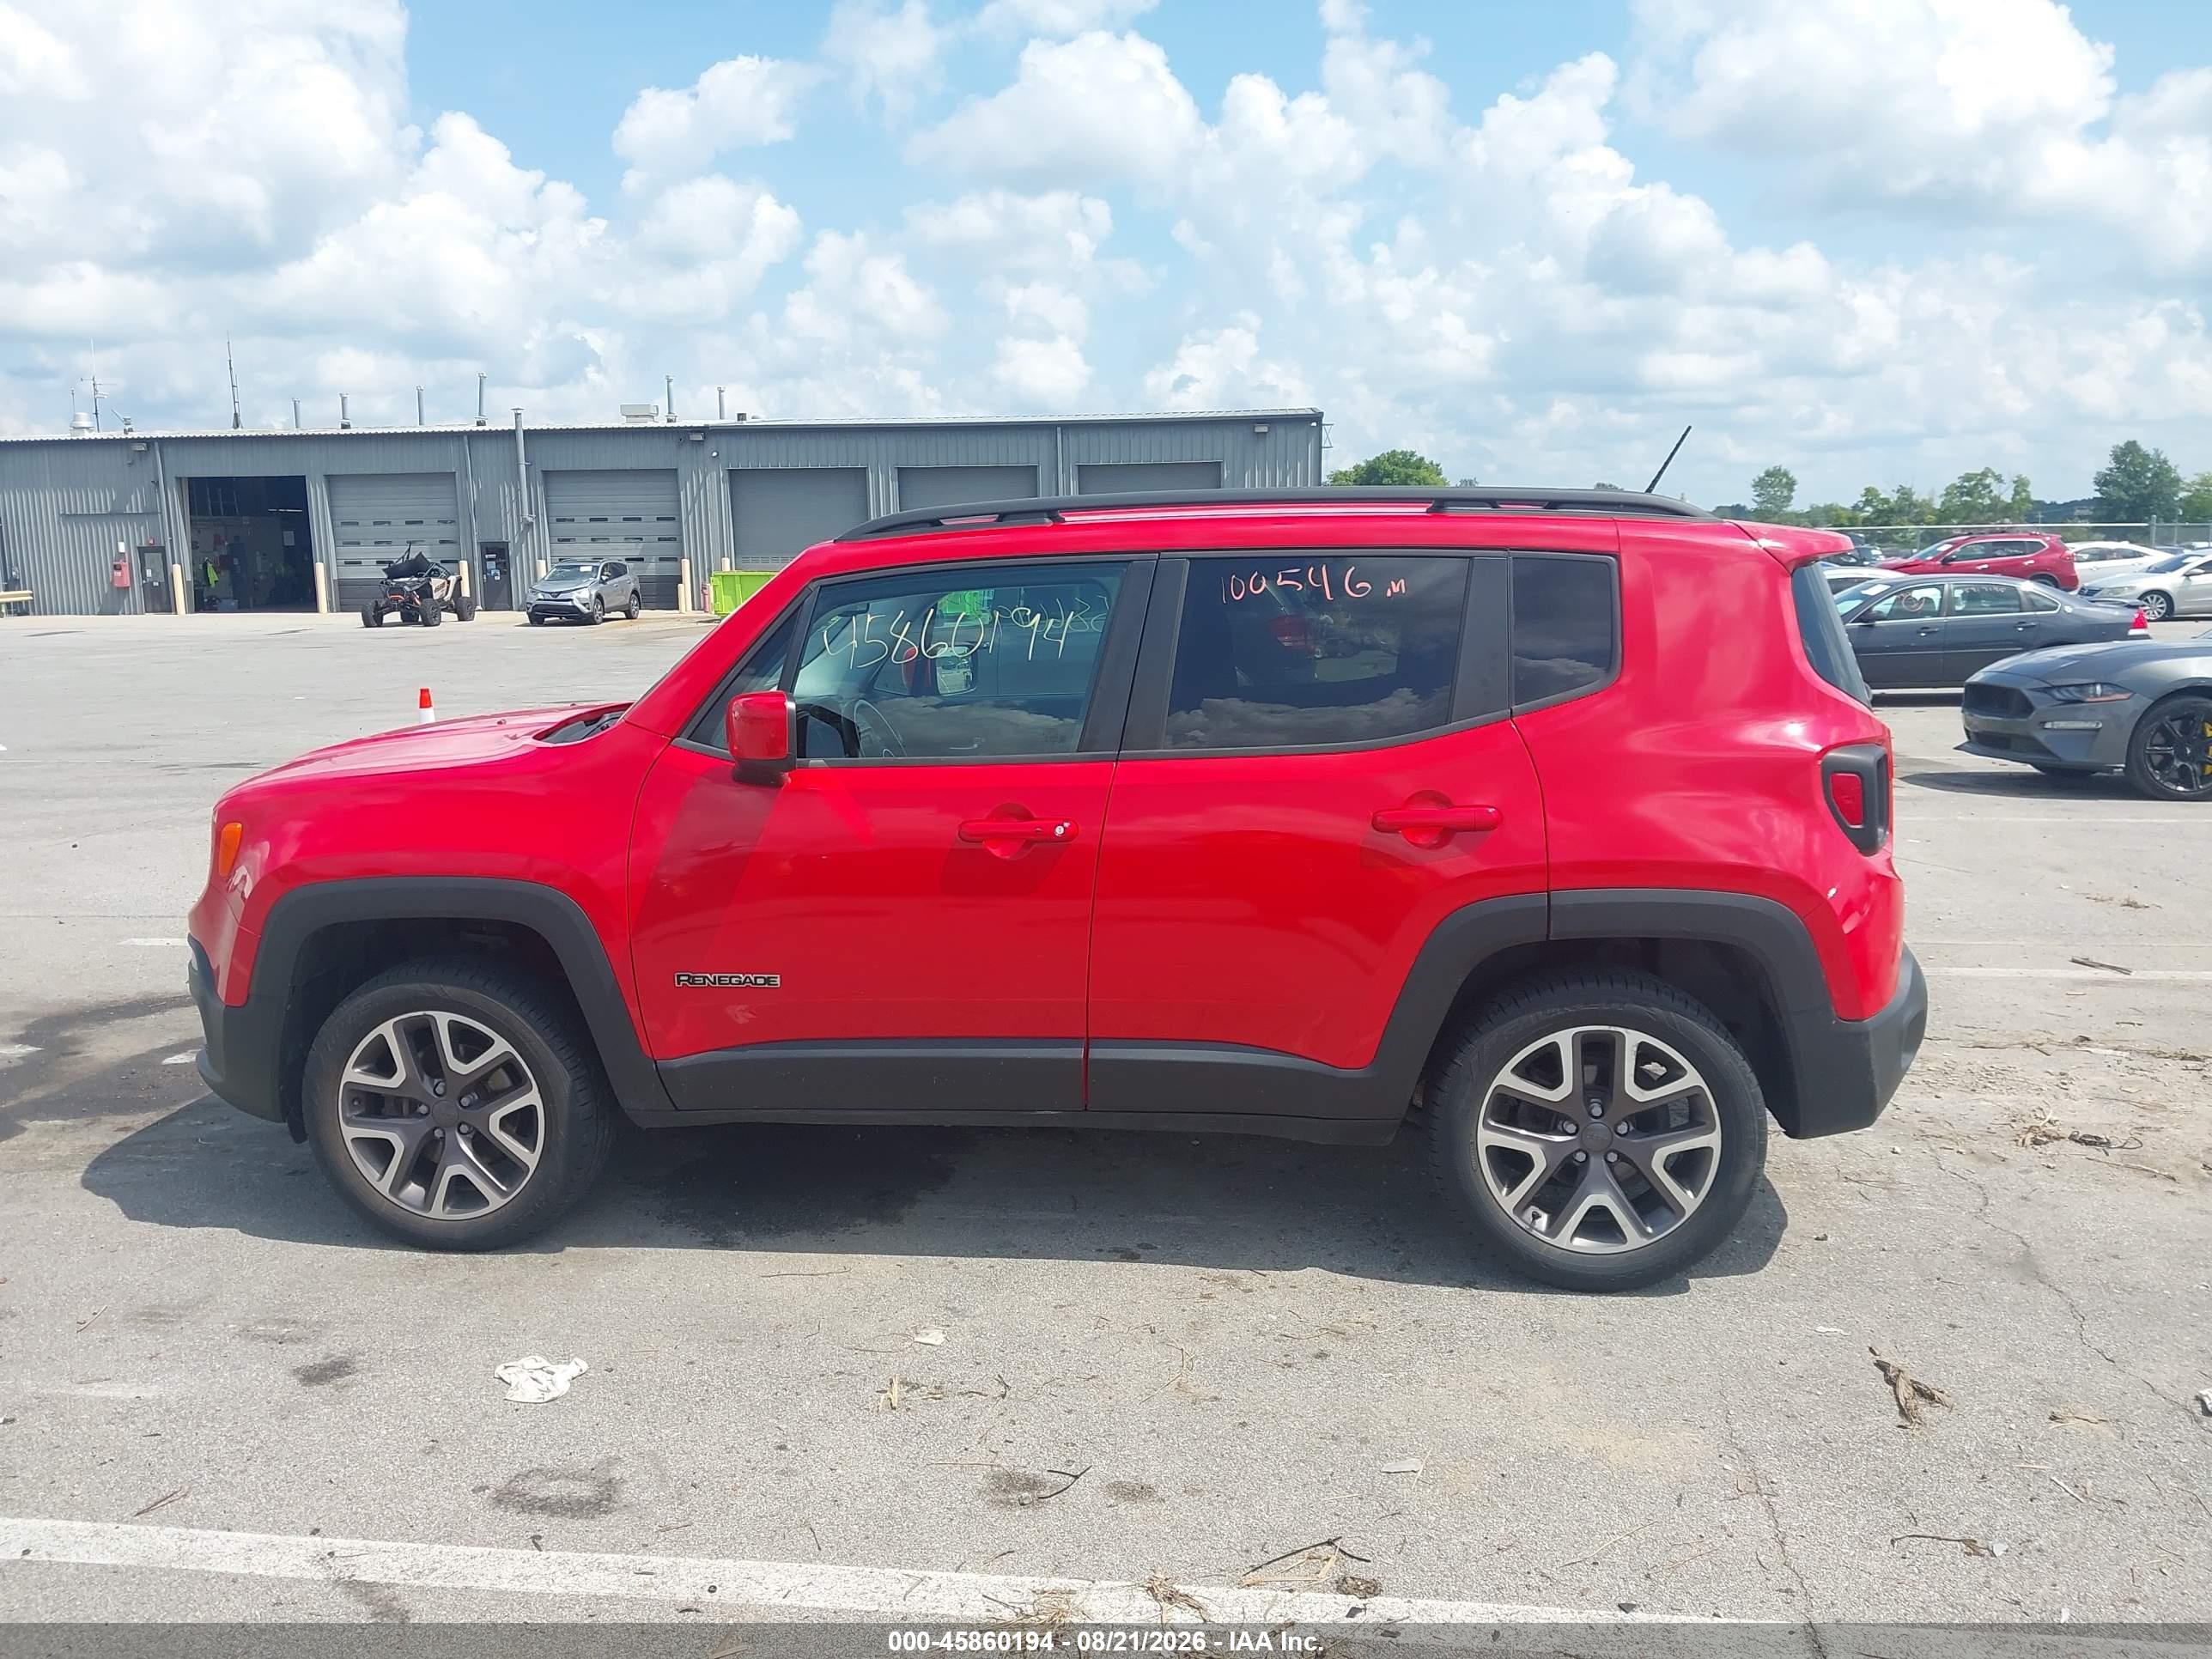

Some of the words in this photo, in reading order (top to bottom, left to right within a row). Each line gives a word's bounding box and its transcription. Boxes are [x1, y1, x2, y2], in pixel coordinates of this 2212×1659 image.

[1220, 563, 1373, 605] 100546
[823, 607, 1075, 671] 45860194
[675, 972, 781, 988] RENEGADE
